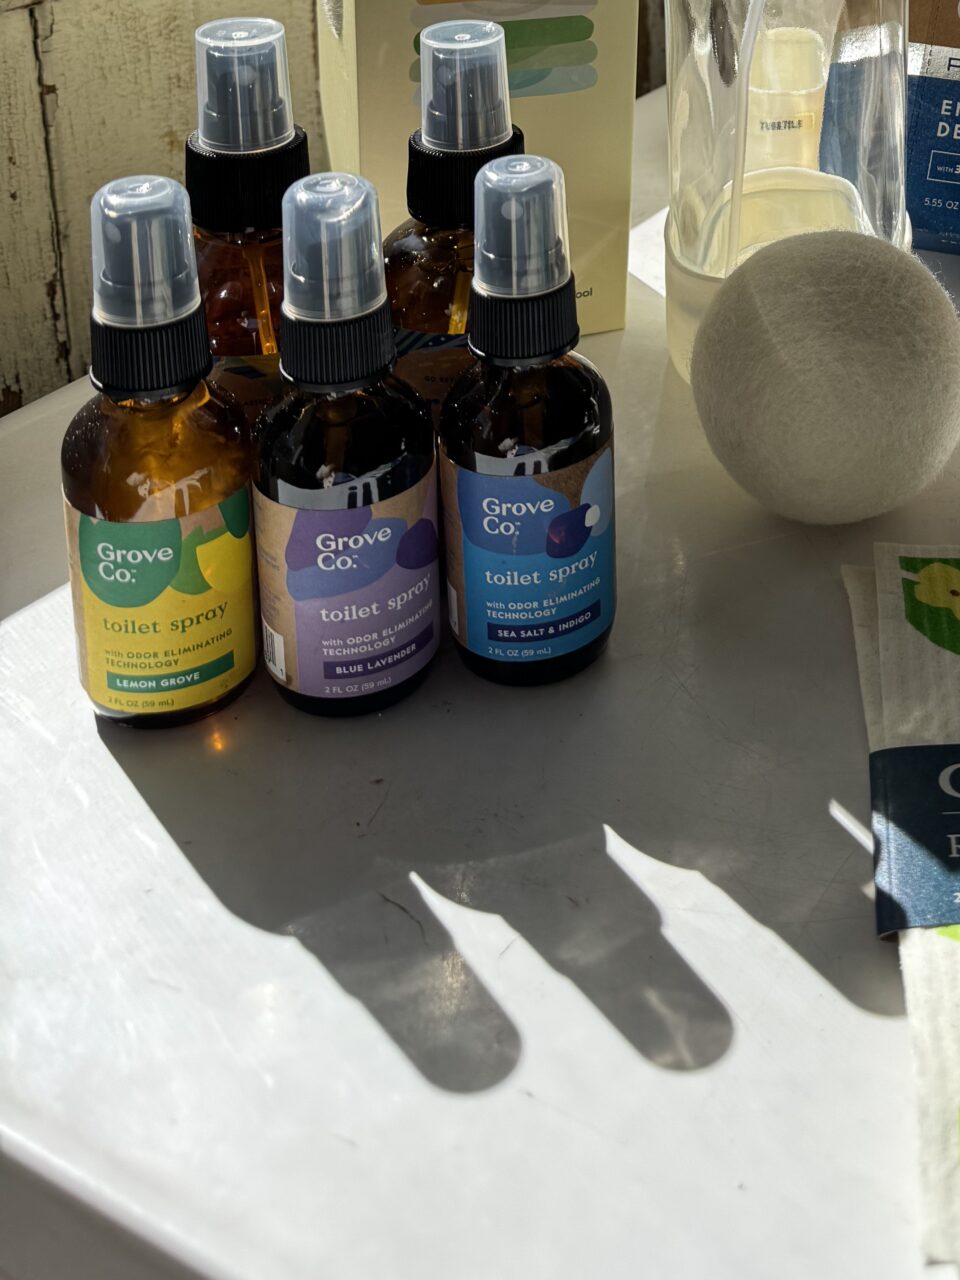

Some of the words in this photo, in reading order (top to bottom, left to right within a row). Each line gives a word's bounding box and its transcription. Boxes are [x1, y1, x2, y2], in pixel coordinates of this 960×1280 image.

[936, 165, 953, 174] WITH
[924, 197, 943, 208] 5.55
[945, 200, 959, 210] OZ
[482, 497, 555, 516] Grove
[315, 527, 392, 551] Grove
[97, 543, 174, 564] Grove
[485, 570, 541, 586] toilet
[549, 551, 598, 583] spray
[320, 601, 381, 622] toilet
[387, 573, 431, 611] spray
[486, 600, 505, 610] with
[508, 601, 539, 610] ODOR
[543, 577, 601, 607] ELIMINATING
[103, 618, 160, 634] toilet
[170, 601, 228, 633] spray
[486, 607, 557, 620] TECHNOLOGY
[497, 629, 517, 638] SEA
[520, 628, 545, 638] SALT
[548, 626, 555, 634] &
[558, 611, 592, 632] INDIGO
[104, 649, 124, 659] with
[126, 650, 159, 659] ODOR
[164, 627, 233, 658] ELIMINATING
[321, 638, 343, 647] with
[346, 633, 379, 645] ODOR
[322, 635, 397, 656] TECHNOLOGY
[335, 664, 363, 674] BLUE
[367, 643, 417, 670] LAVENDER
[488, 647, 493, 655] 2
[495, 648, 505, 656] FL
[507, 649, 519, 657] OZ
[521, 648, 534, 657] (59
[106, 658, 180, 670] TECHNOLOGY
[116, 678, 156, 688] LEMON
[160, 671, 200, 687] GROVE
